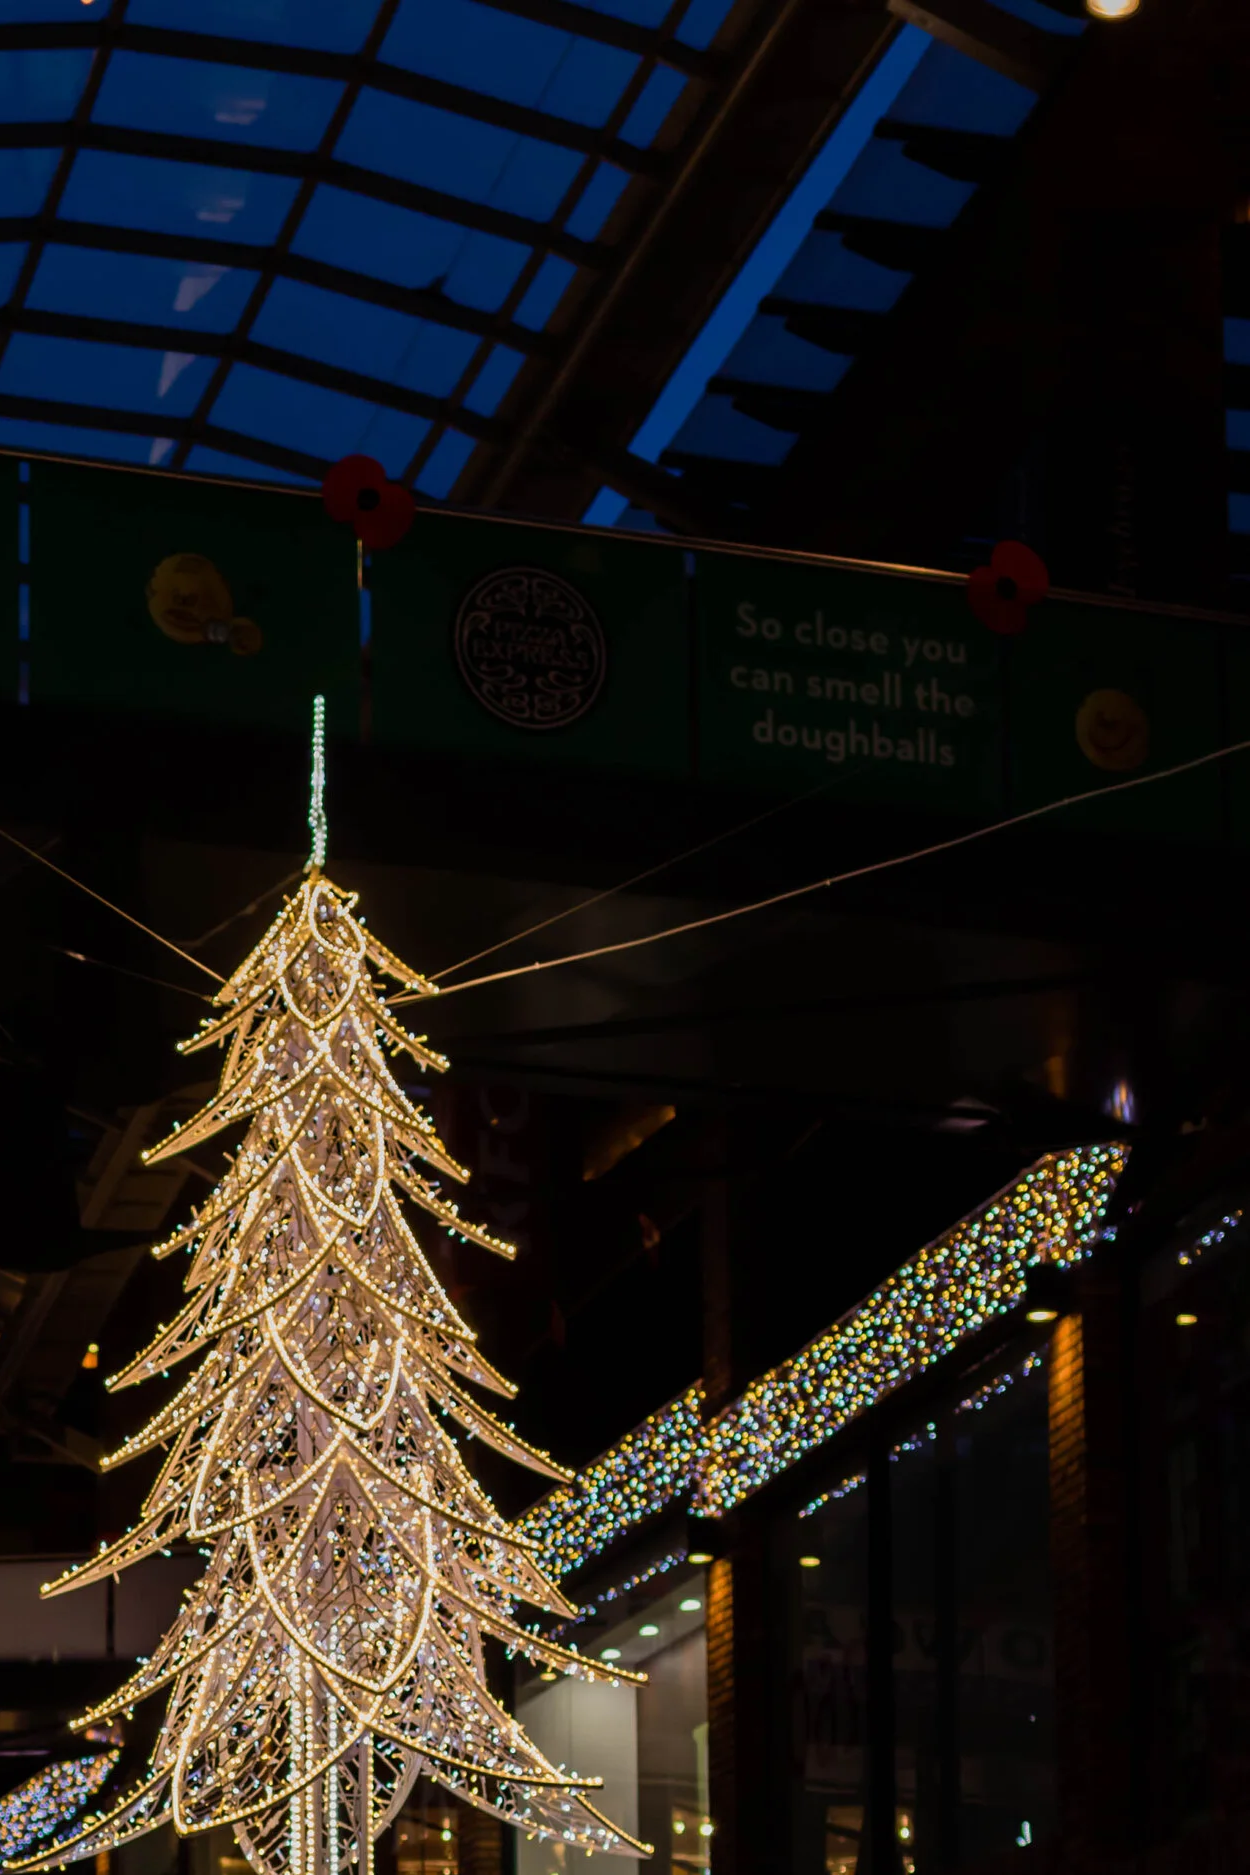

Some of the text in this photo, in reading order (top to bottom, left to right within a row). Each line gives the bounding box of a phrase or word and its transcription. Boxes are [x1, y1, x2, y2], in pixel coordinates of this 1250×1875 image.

[734, 600, 968, 668] So close you
[729, 665, 975, 718] can smell the
[751, 708, 956, 768] doughballs
